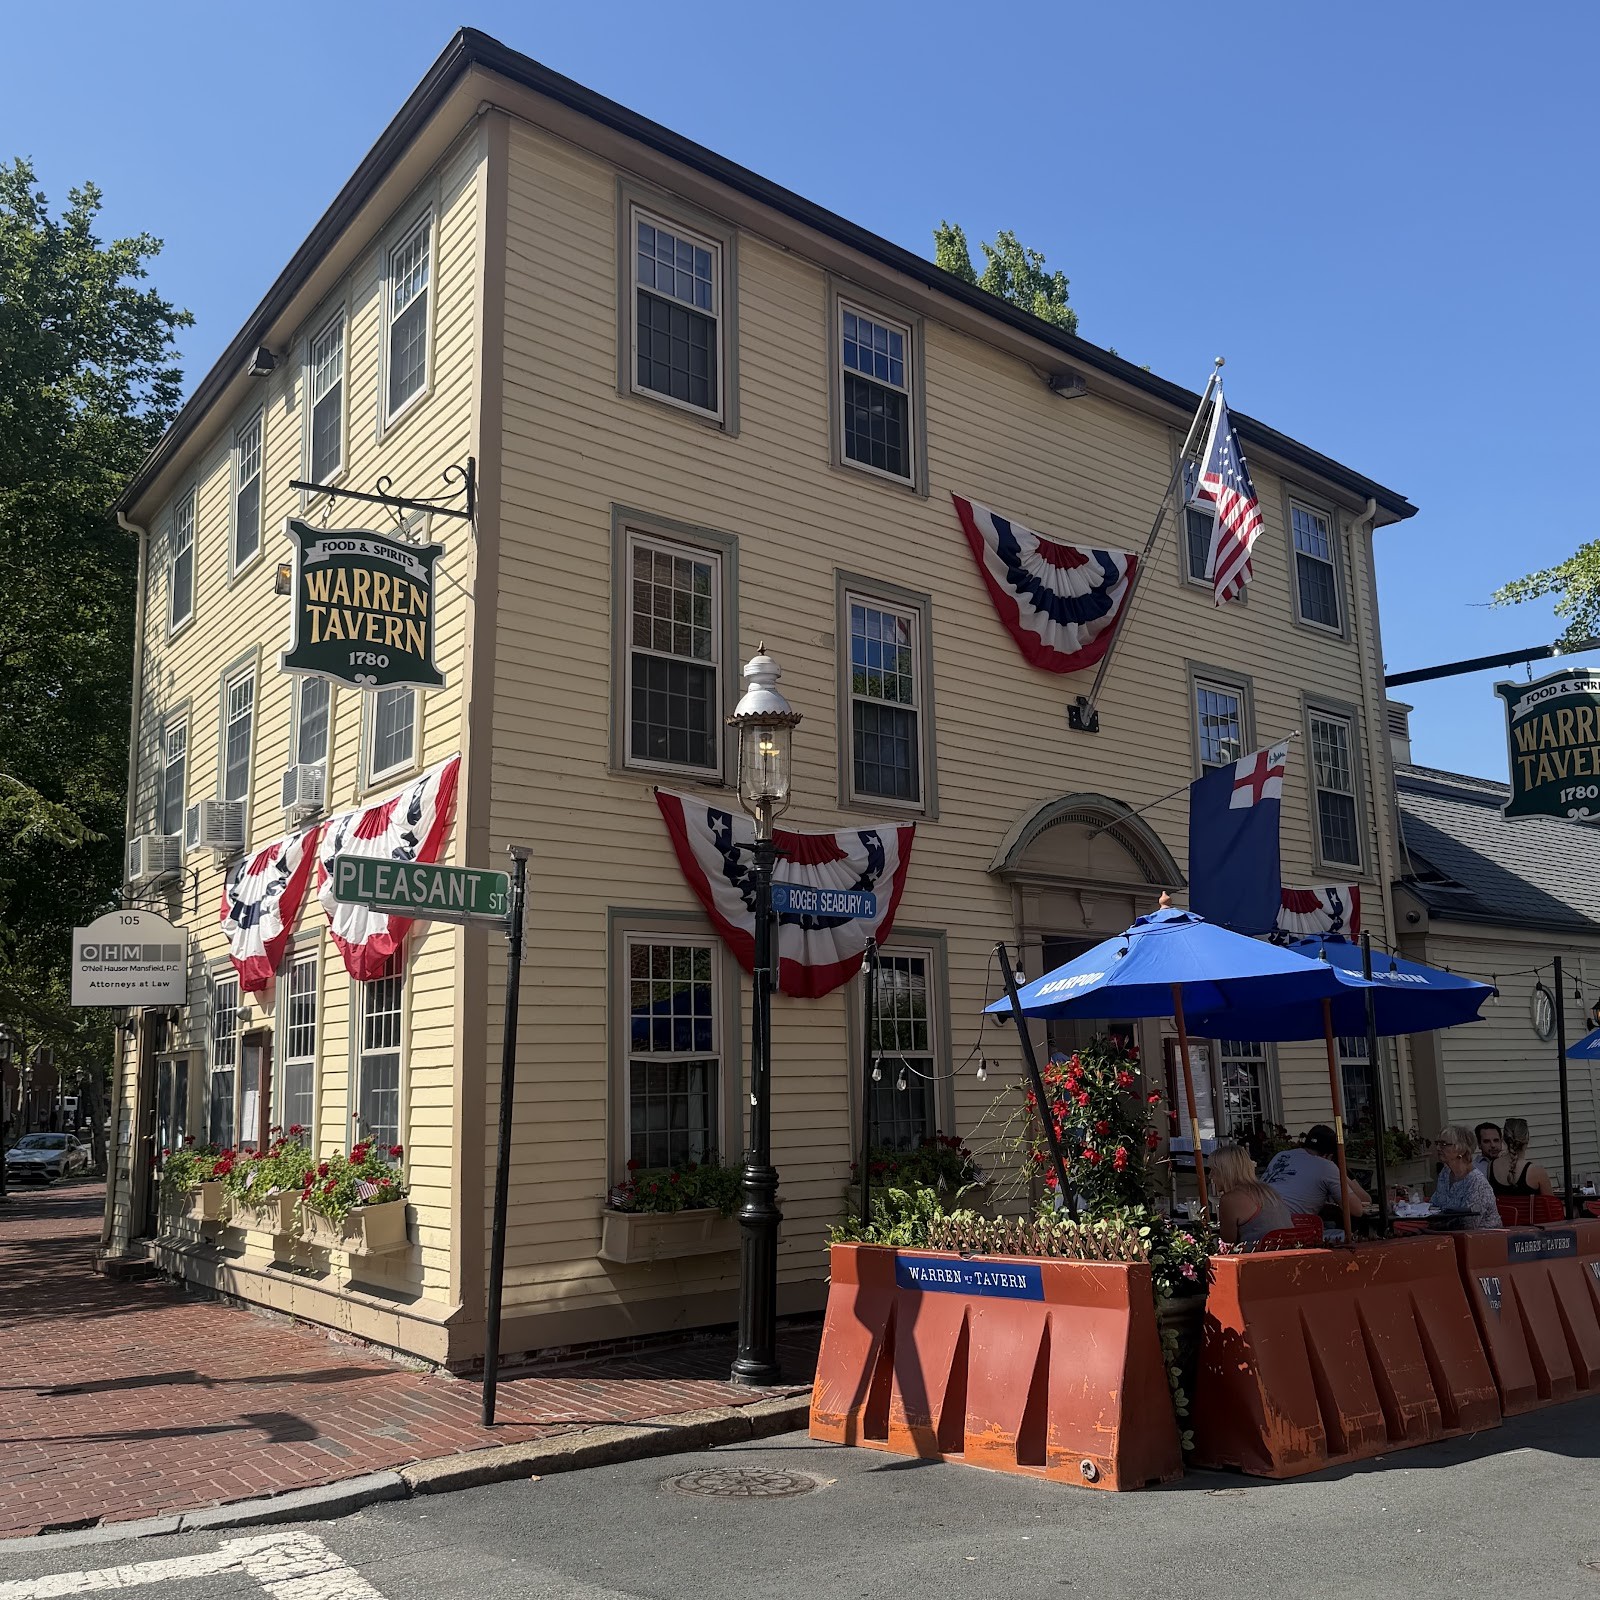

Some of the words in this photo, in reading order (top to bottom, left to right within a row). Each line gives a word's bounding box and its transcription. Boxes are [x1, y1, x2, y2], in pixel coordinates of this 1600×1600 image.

[322, 541, 356, 552] FOOD
[359, 543, 370, 553] &
[374, 545, 414, 567] SPIRITS
[304, 567, 428, 618] WARREN
[306, 604, 426, 660] TAVERN
[349, 651, 390, 669] 1780
[1526, 686, 1557, 706] FOOD
[1560, 683, 1571, 693] &
[1560, 784, 1599, 804] 1780
[338, 861, 481, 908] PLEASANT
[489, 893, 504, 910] ST
[789, 889, 818, 911] ROGER
[820, 892, 862, 914] SEABURY
[864, 900, 873, 915] PL
[119, 916, 140, 925] 105
[83, 946, 140, 960] OHM
[1514, 1239, 1541, 1253] WARREN
[1547, 1238, 1570, 1251] TAVERN
[909, 1266, 962, 1283] WARREN
[974, 1271, 1027, 1289] TAVERN
